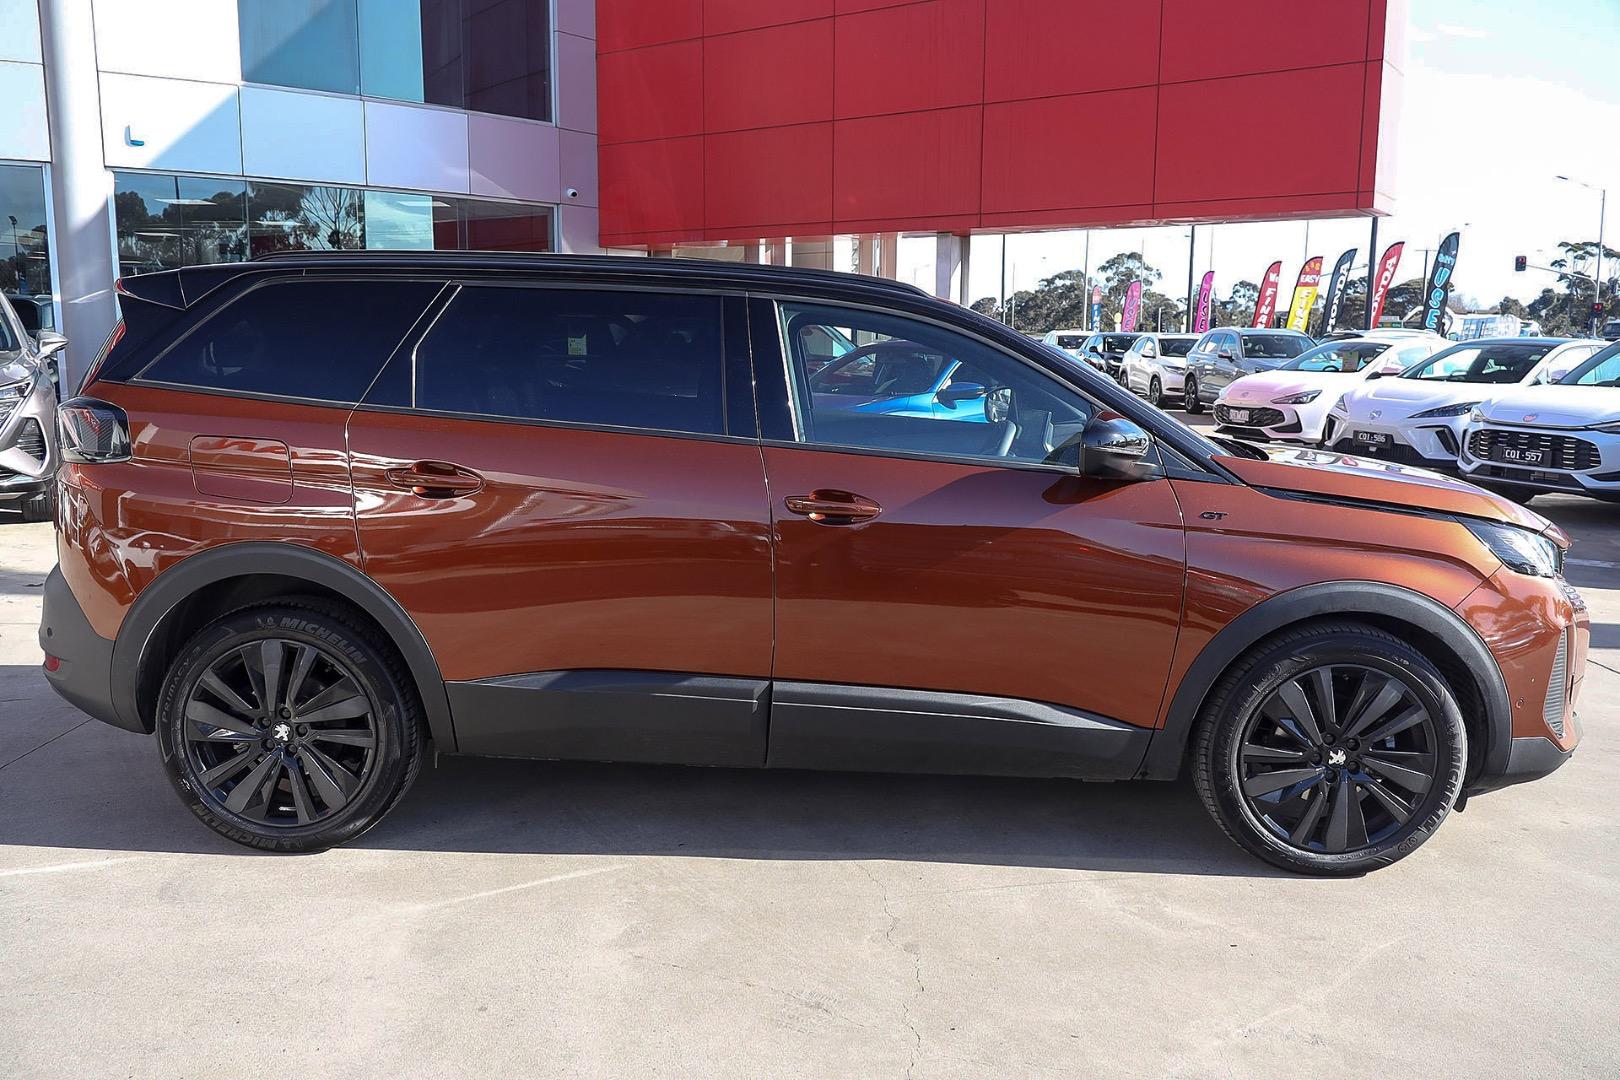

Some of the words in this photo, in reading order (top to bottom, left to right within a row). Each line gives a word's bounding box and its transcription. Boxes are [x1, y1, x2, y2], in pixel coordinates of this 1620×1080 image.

[1371, 255, 1397, 317] ONDA
[1424, 266, 1451, 332] USE
[1199, 511, 1230, 520] GT
[280, 616, 368, 664] MICHELIN
[162, 656, 190, 724] PRIMACY
